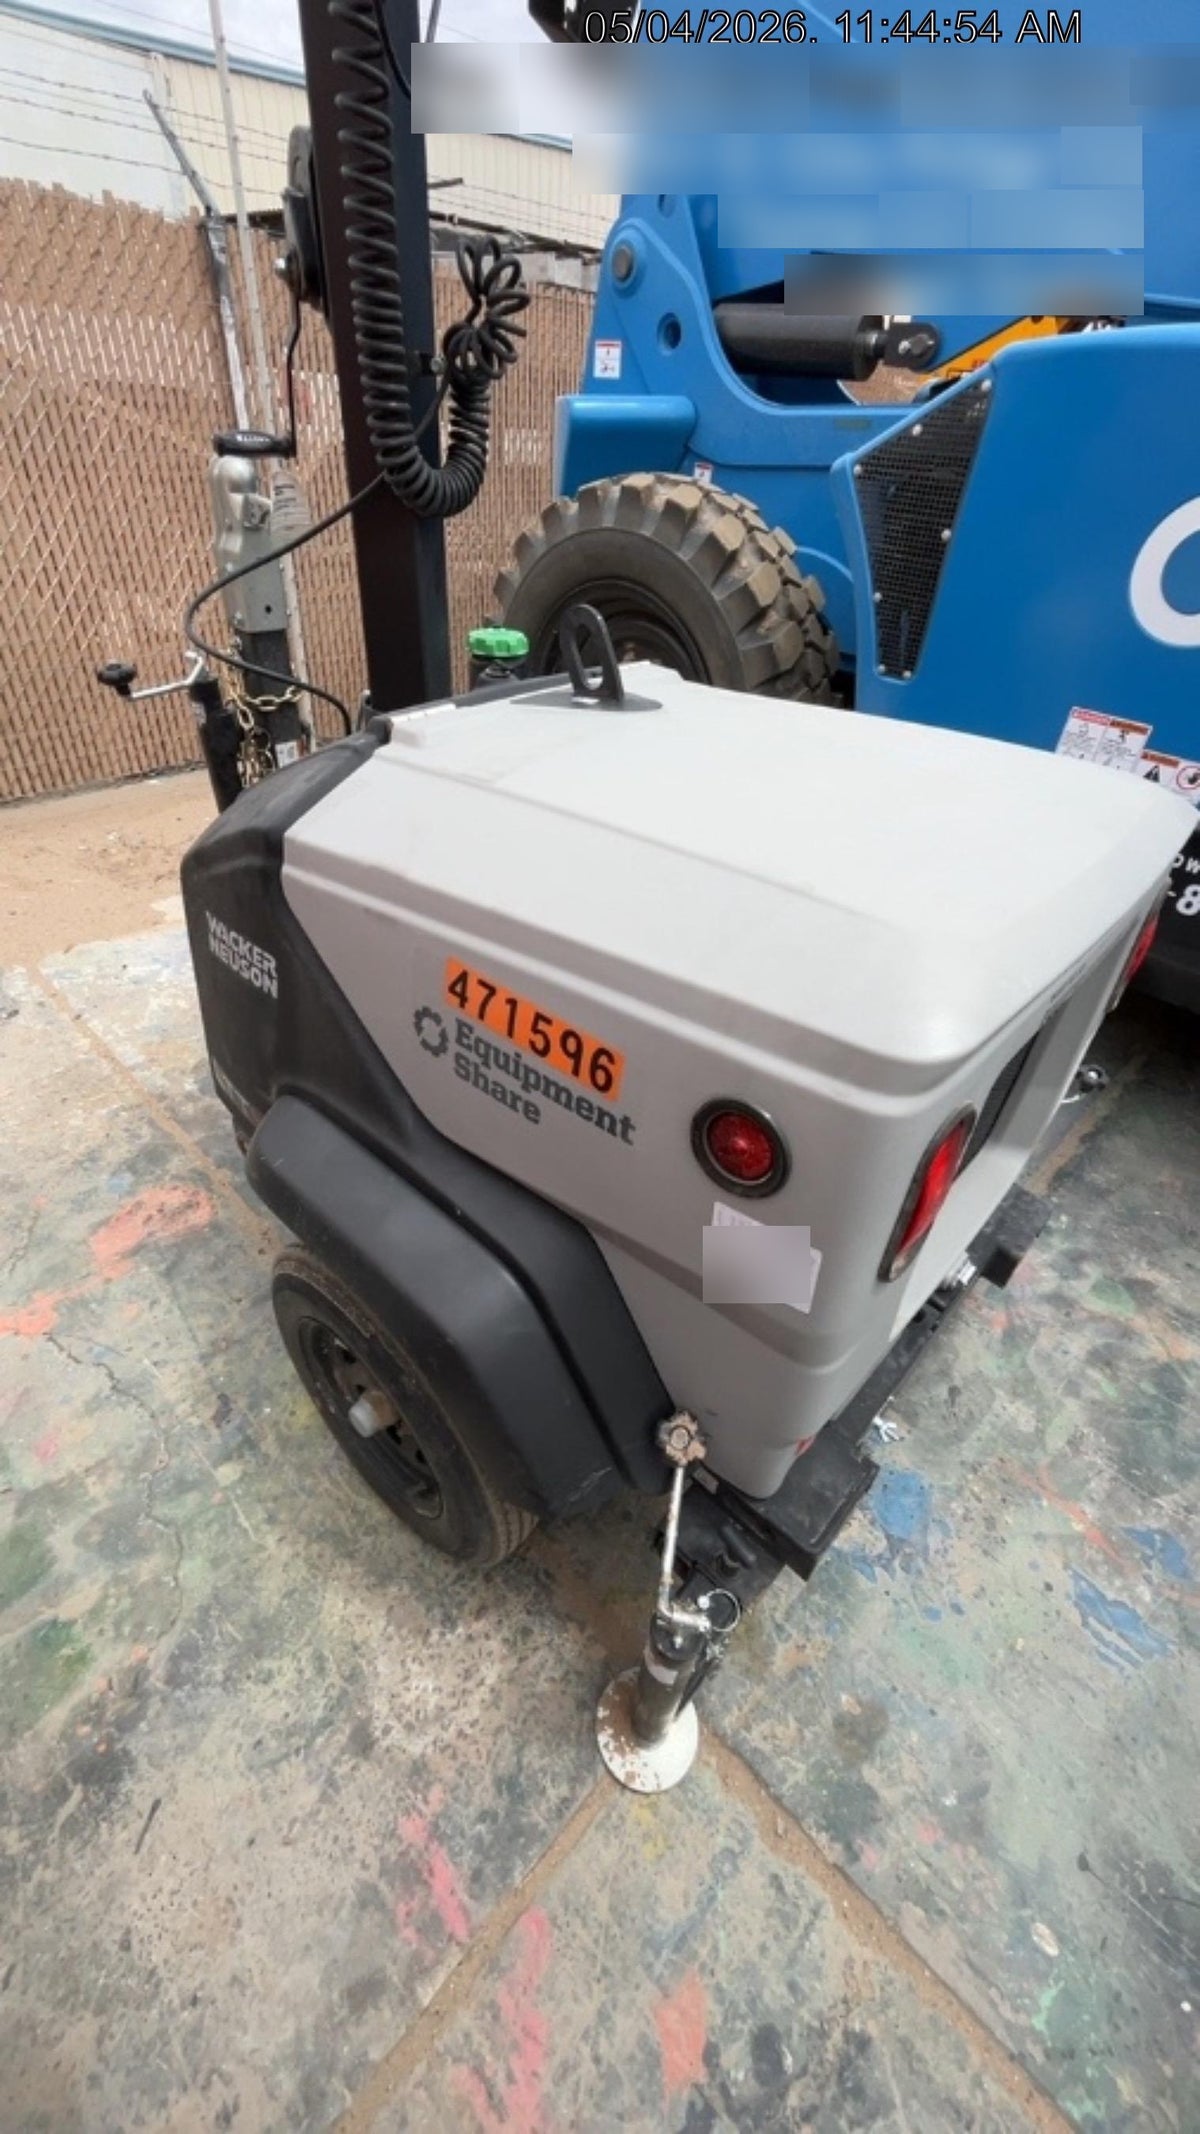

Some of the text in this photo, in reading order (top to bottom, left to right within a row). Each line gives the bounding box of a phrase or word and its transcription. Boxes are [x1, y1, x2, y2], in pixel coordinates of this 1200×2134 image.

[206, 911, 278, 978] WACKER
[208, 932, 278, 999] NEUSON
[447, 969, 616, 1094] 471596
[452, 1052, 542, 1125] Share
[454, 1017, 637, 1146] Equipment
